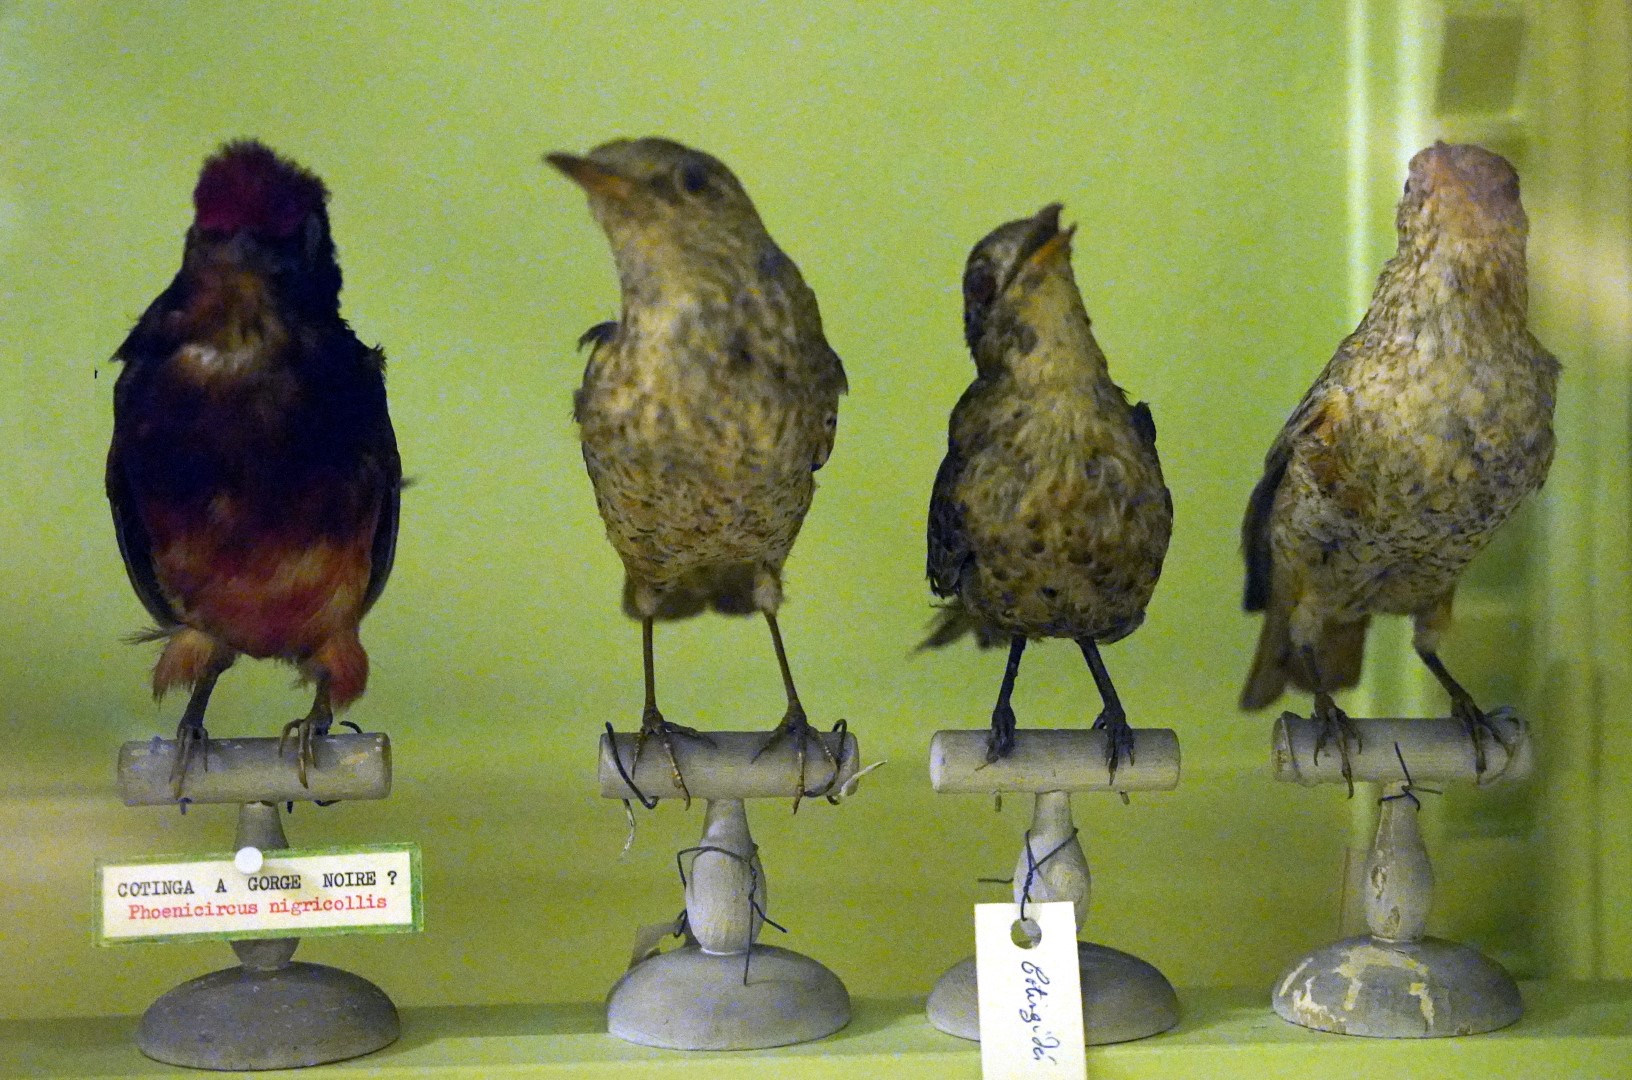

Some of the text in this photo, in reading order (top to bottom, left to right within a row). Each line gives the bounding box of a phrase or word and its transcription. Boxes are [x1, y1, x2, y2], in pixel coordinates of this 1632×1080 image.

[117, 880, 195, 898] COTINGA
[215, 877, 228, 894] A
[247, 874, 302, 892] GORGE
[322, 871, 377, 888] NOIRE
[128, 894, 388, 921] Phoenicircus nigricollis
